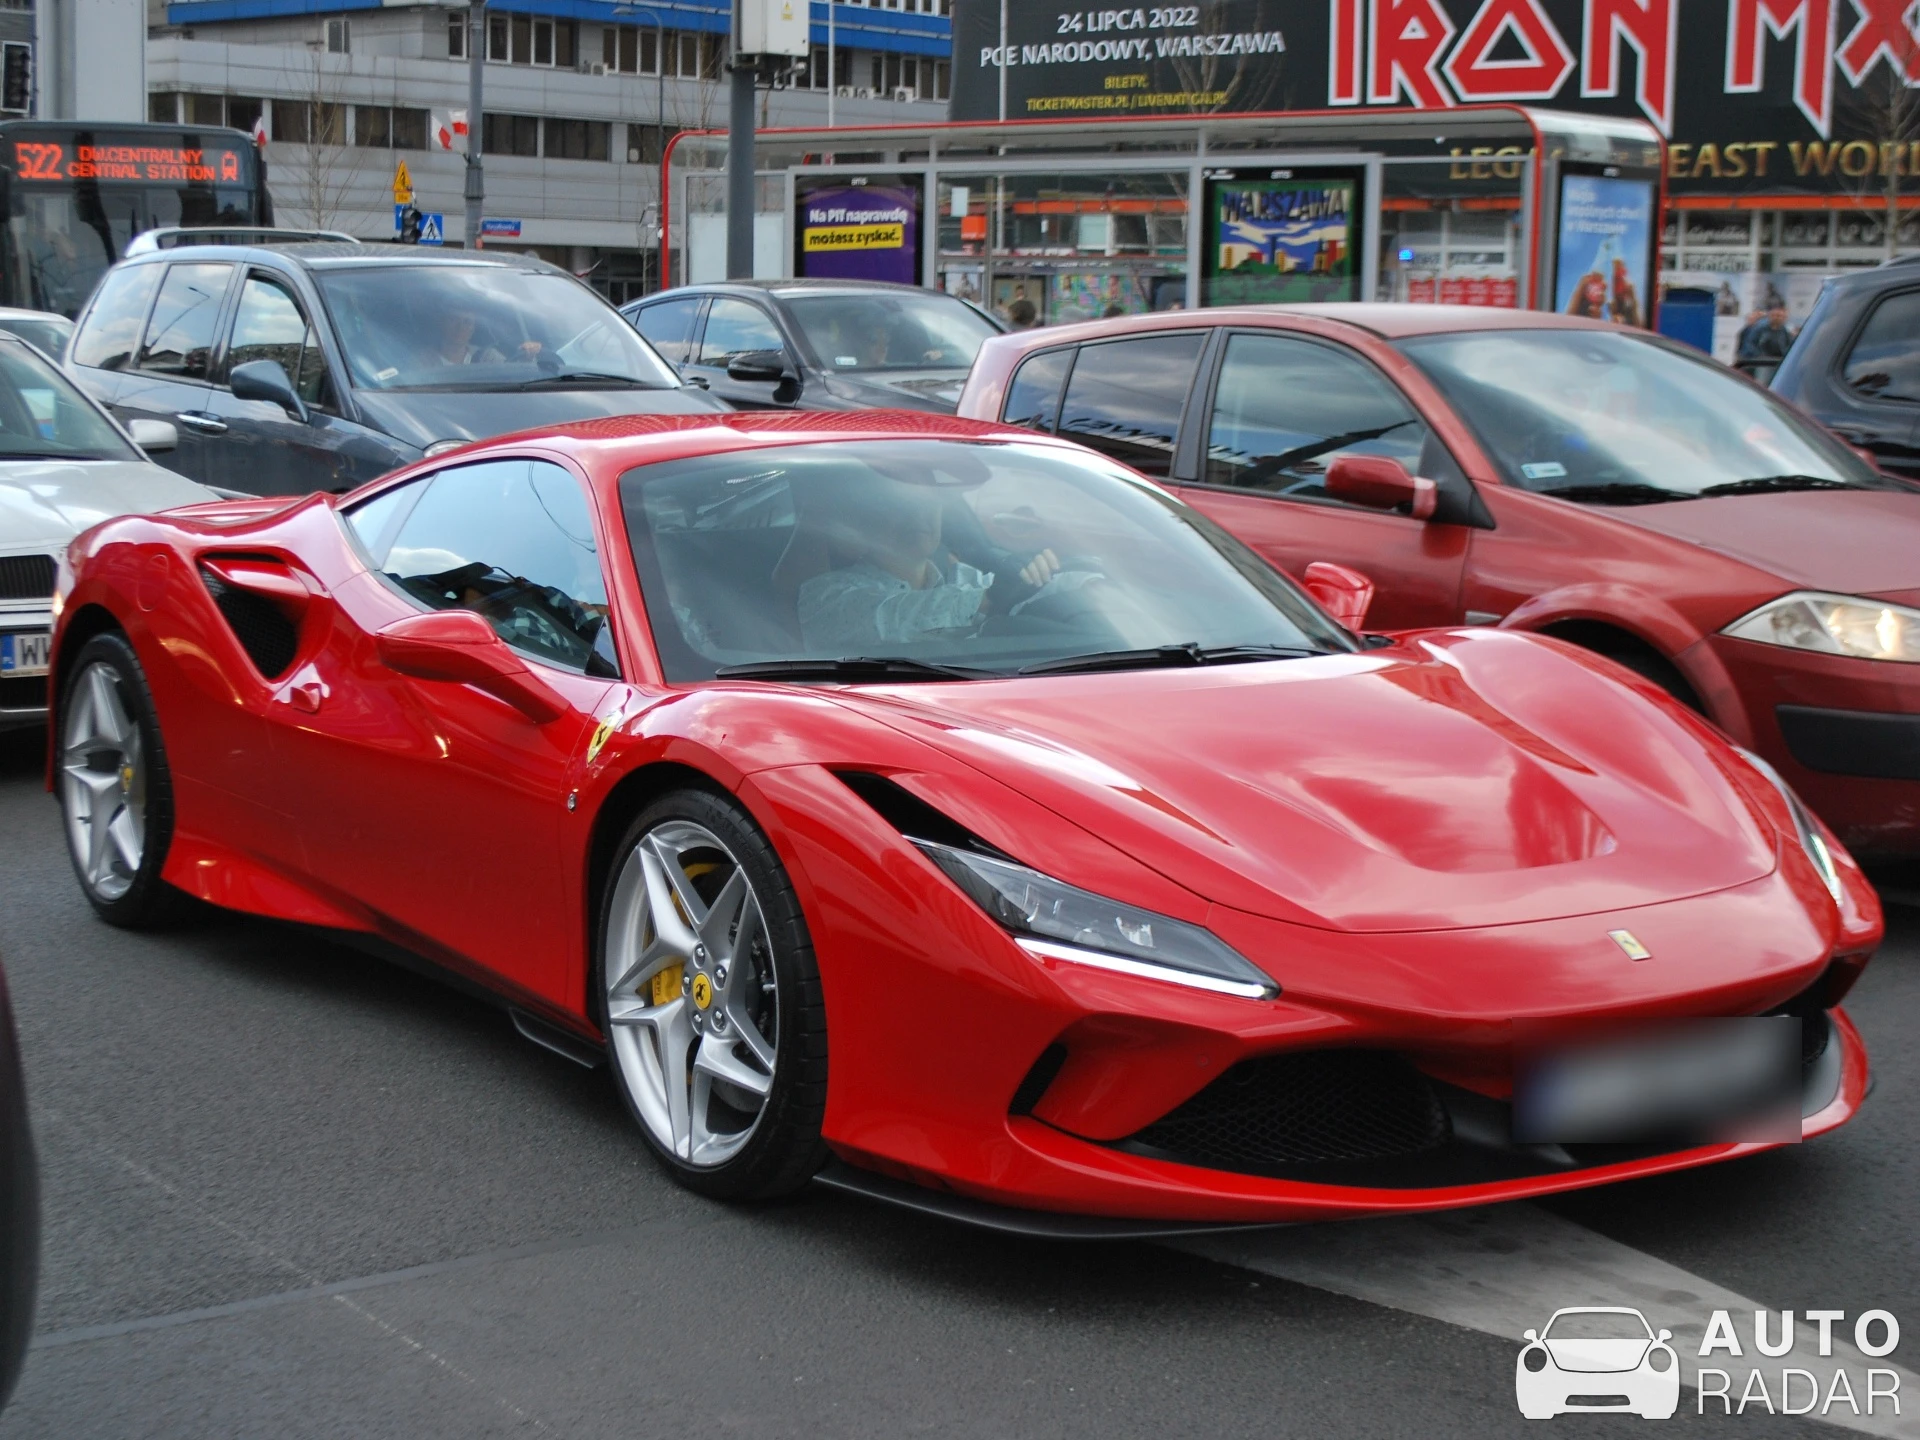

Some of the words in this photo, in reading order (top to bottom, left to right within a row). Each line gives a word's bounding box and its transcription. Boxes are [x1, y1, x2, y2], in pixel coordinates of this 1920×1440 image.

[1056, 13, 1084, 34] 24
[1087, 9, 1147, 33] LIPCA
[1148, 6, 1199, 29] 2022
[1021, 38, 1152, 65] NARODOWY,
[1156, 31, 1286, 58] WARSZAWA
[1328, 0, 1676, 138] IRON
[1137, 91, 1229, 108] LIVENATON.PL
[14, 142, 63, 180] 522
[66, 161, 142, 179] CENTRAL
[146, 164, 216, 181] STATION
[809, 208, 827, 223] Na
[827, 207, 846, 223] PIT
[845, 206, 908, 225] naprawdę
[809, 231, 854, 246] możesz
